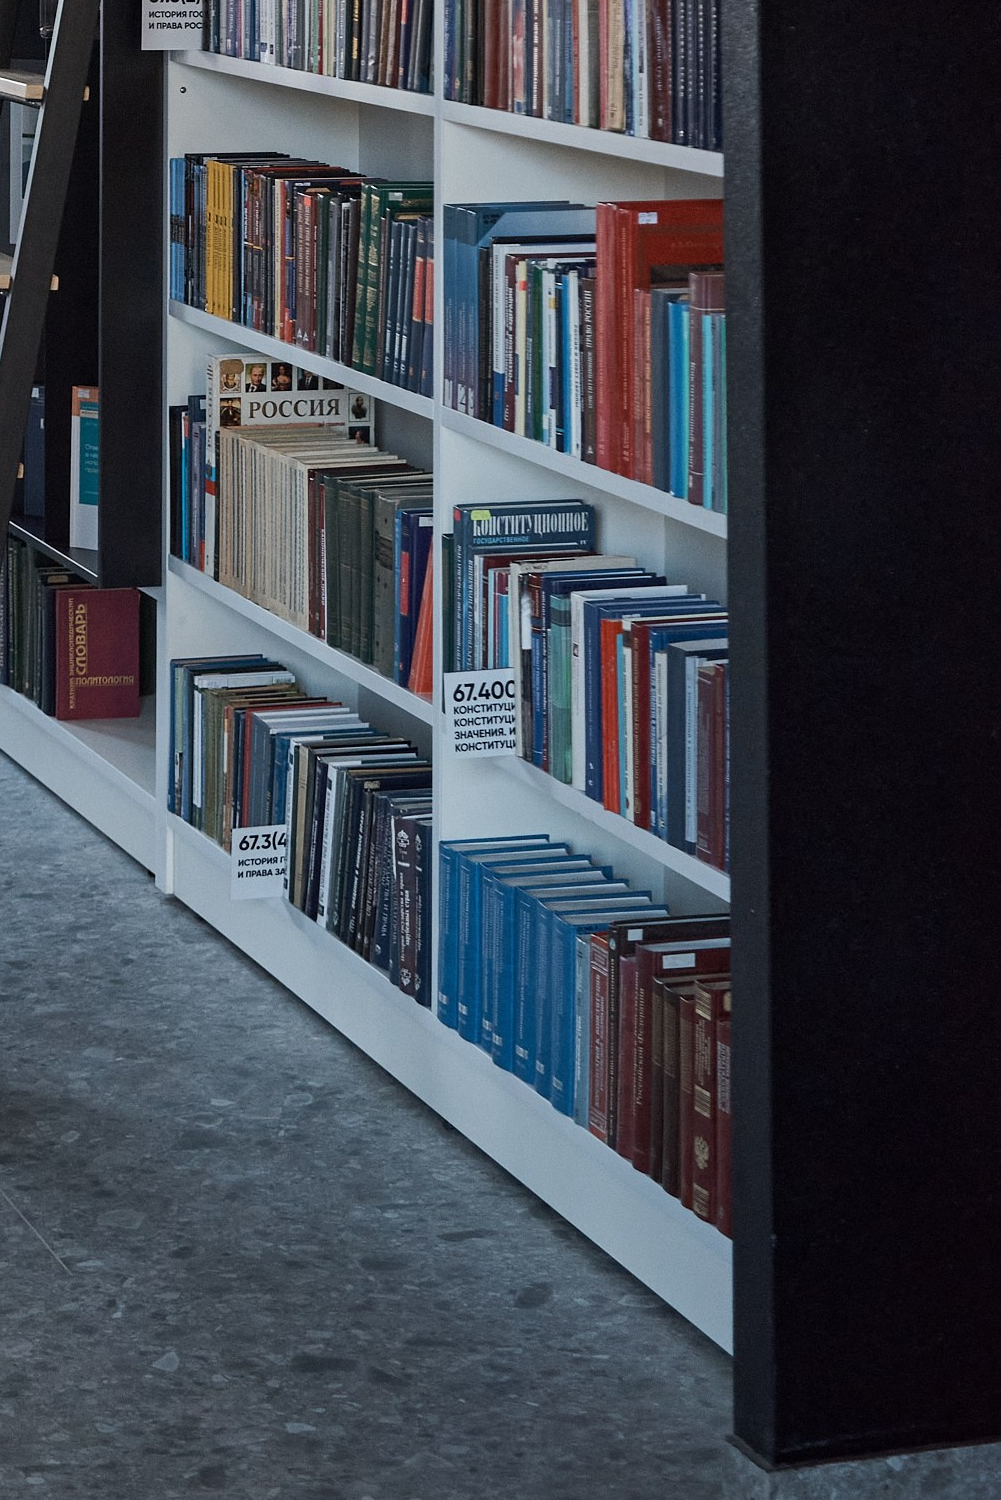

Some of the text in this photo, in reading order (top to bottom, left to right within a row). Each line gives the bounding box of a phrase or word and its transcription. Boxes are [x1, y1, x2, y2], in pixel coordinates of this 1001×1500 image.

[149, 10, 187, 18] ИСТОРИЯ
[149, 22, 155, 30] И
[157, 22, 183, 30] ПРАВА
[584, 290, 592, 322] РОССИИ
[249, 398, 340, 419] РОССИЯ
[472, 535, 530, 545] ГОСУДАРСТВЕННОЕ
[75, 603, 87, 676] СЛОВАРЬ
[75, 676, 135, 686] ПОЛИТОЛОГИЯ
[453, 679, 515, 703] 67.400
[454, 727, 507, 740] ЗНАЧЕНИЯ.
[239, 831, 287, 851] 67.3(4
[238, 856, 278, 867] ИСТОРИЯ
[237, 870, 244, 879] И
[245, 868, 273, 878] ПРАВА
[636, 1046, 644, 1105] Российской
